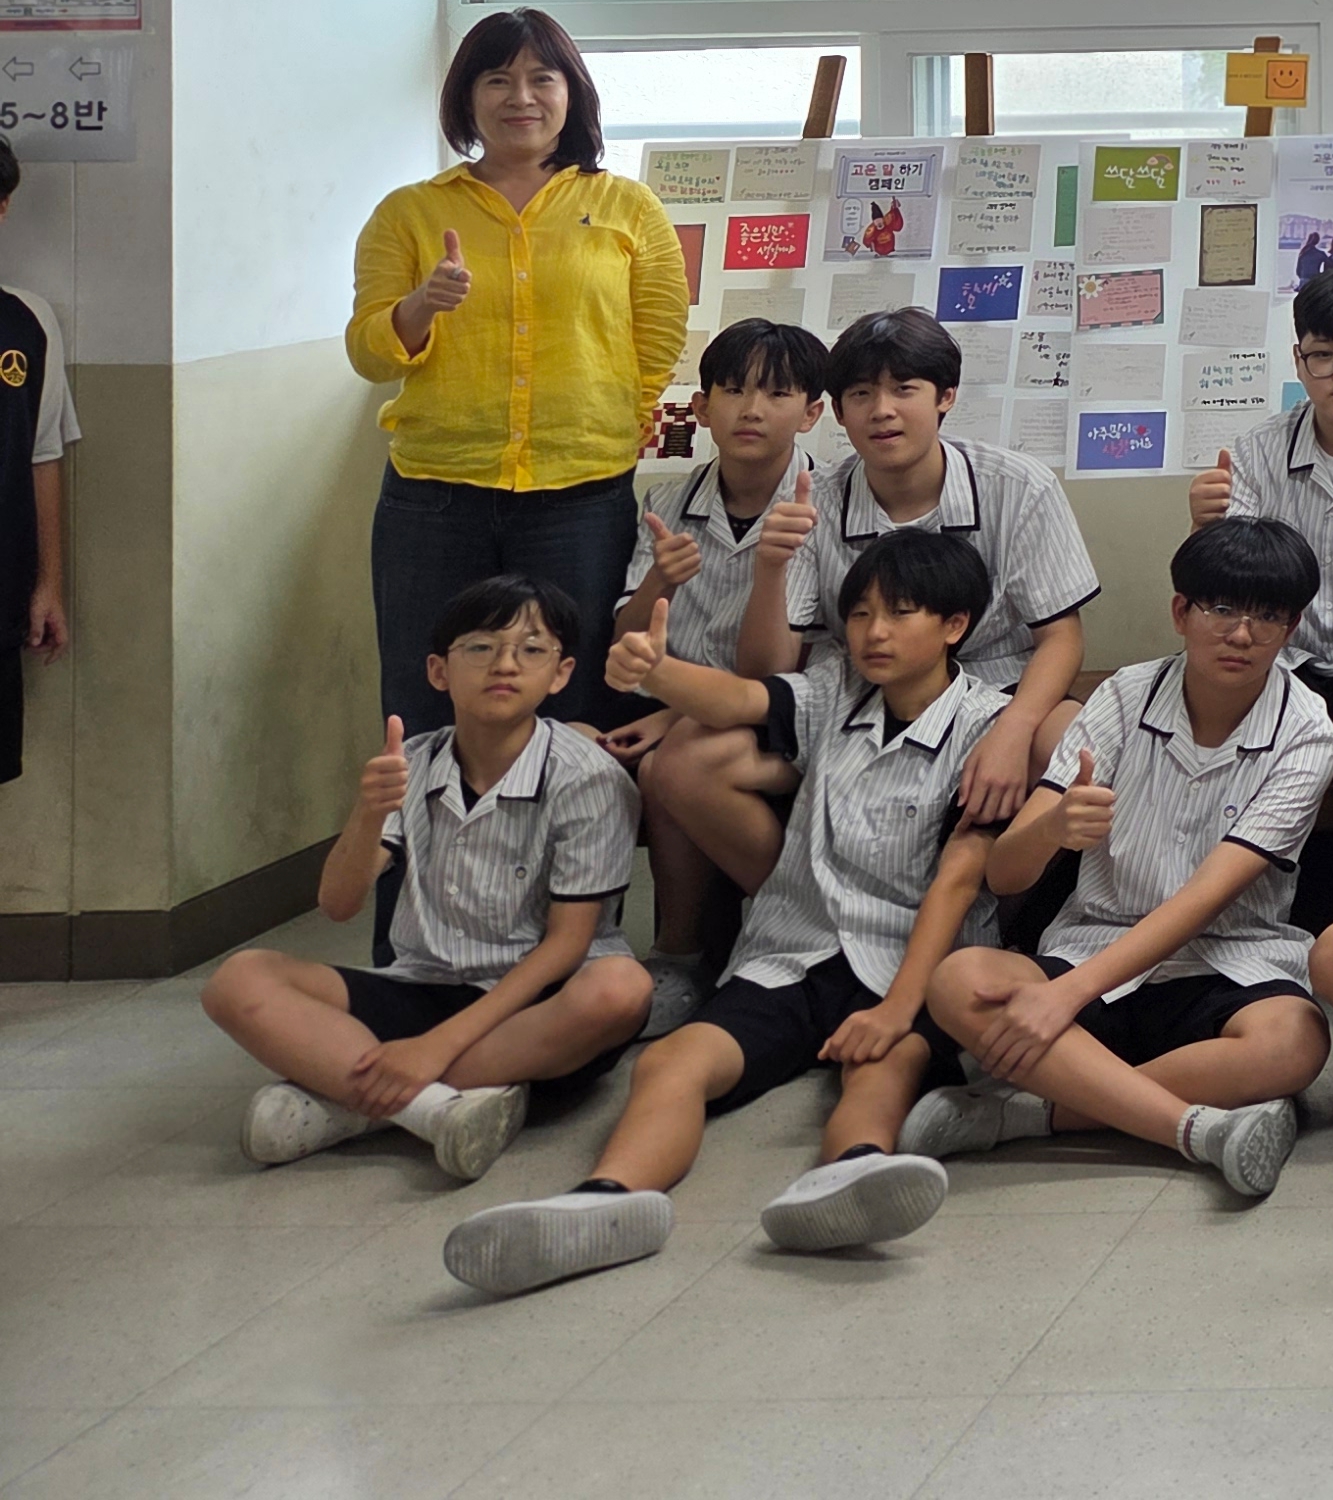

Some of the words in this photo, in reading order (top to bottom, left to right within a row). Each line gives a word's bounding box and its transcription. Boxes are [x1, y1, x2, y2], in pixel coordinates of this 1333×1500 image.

[0, 100, 108, 131] 5~8반
[851, 163, 877, 177] 고운
[882, 163, 894, 177] 말
[899, 163, 923, 176] 하기
[1103, 164, 1168, 190] 쓰담쓰담
[868, 178, 905, 191] 캠페인
